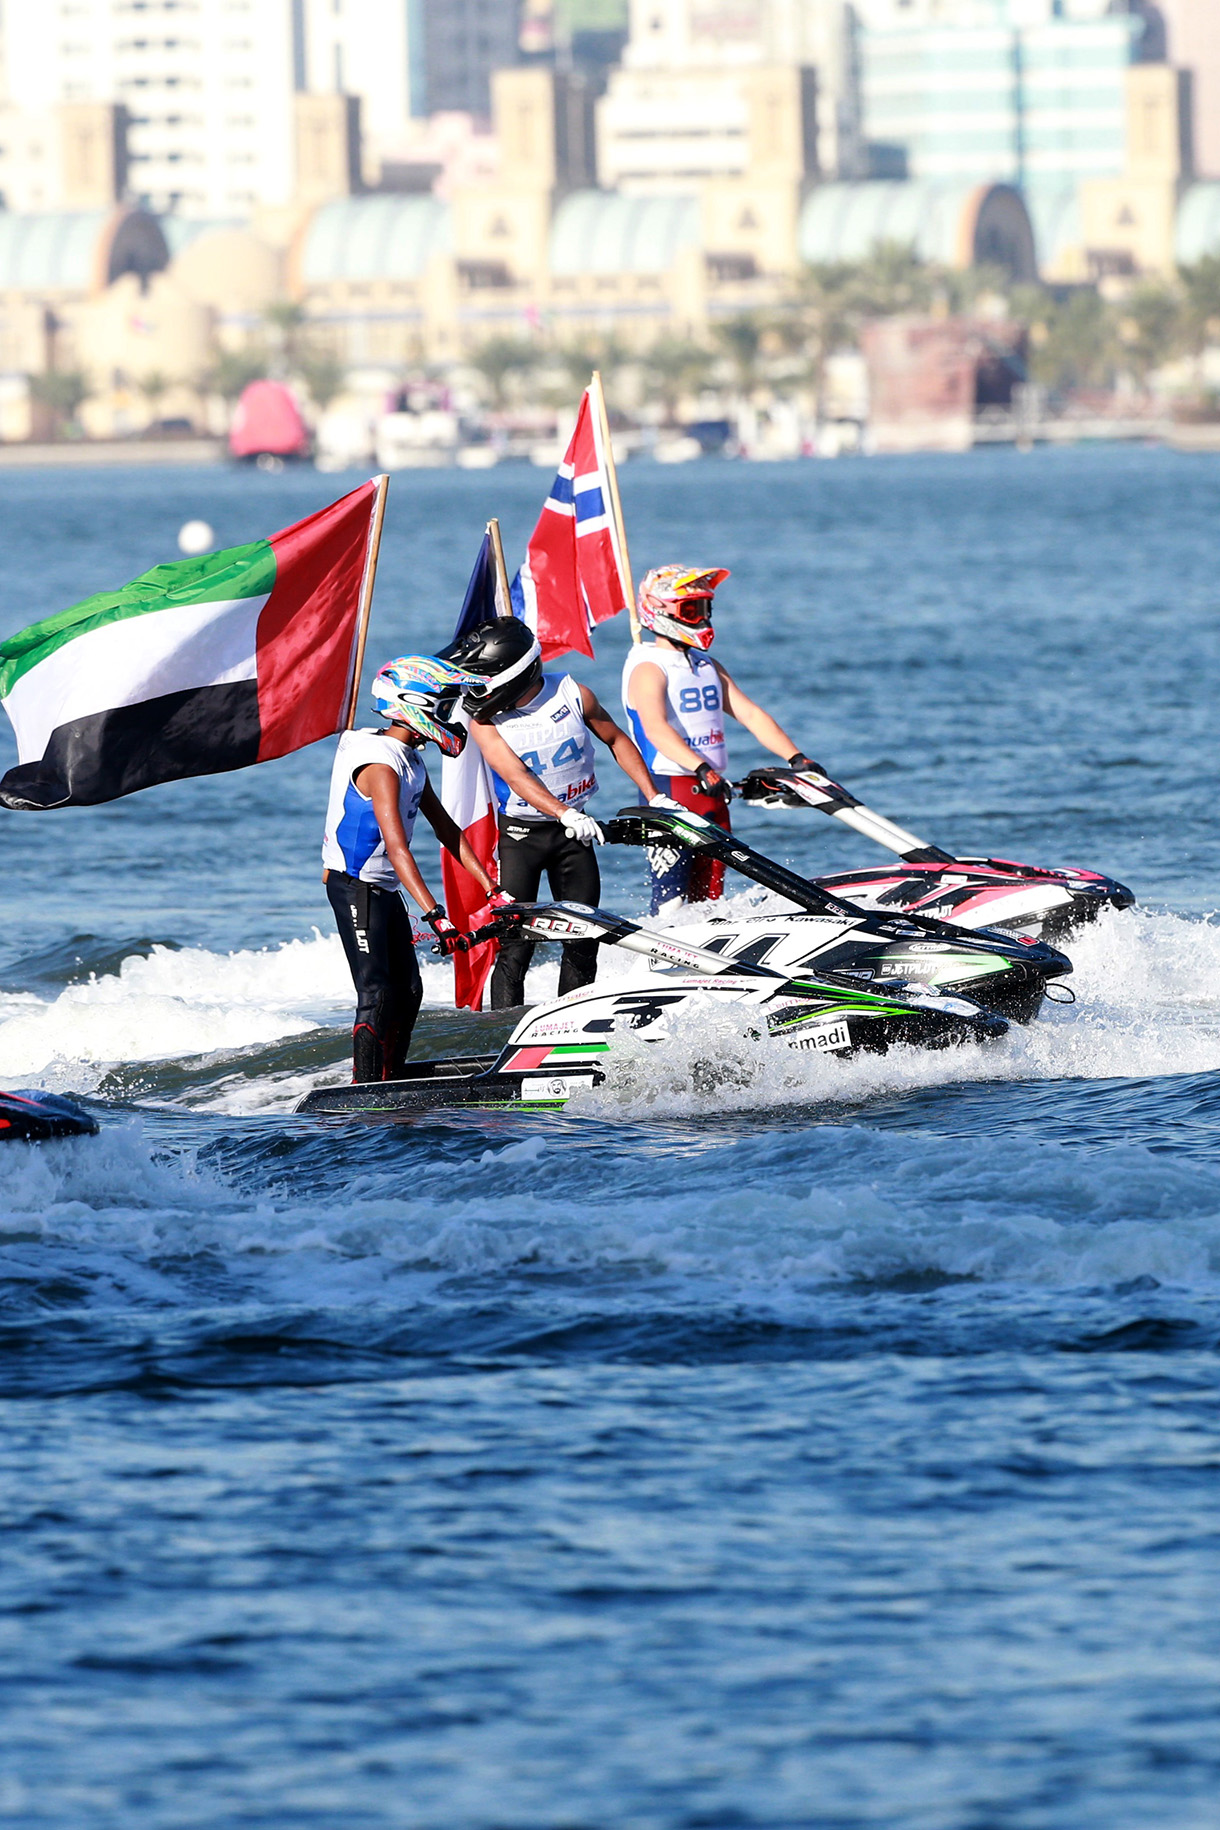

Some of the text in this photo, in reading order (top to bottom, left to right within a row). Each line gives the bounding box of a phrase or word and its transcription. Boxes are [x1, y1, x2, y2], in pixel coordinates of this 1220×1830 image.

[679, 684, 720, 713] 88
[519, 737, 585, 775] 44
[784, 914, 855, 926] Kawasaki
[649, 947, 700, 969] RACING
[891, 963, 938, 975] JETPILOT
[530, 1027, 579, 1038] RACING
[535, 1020, 575, 1033] LUMAJET
